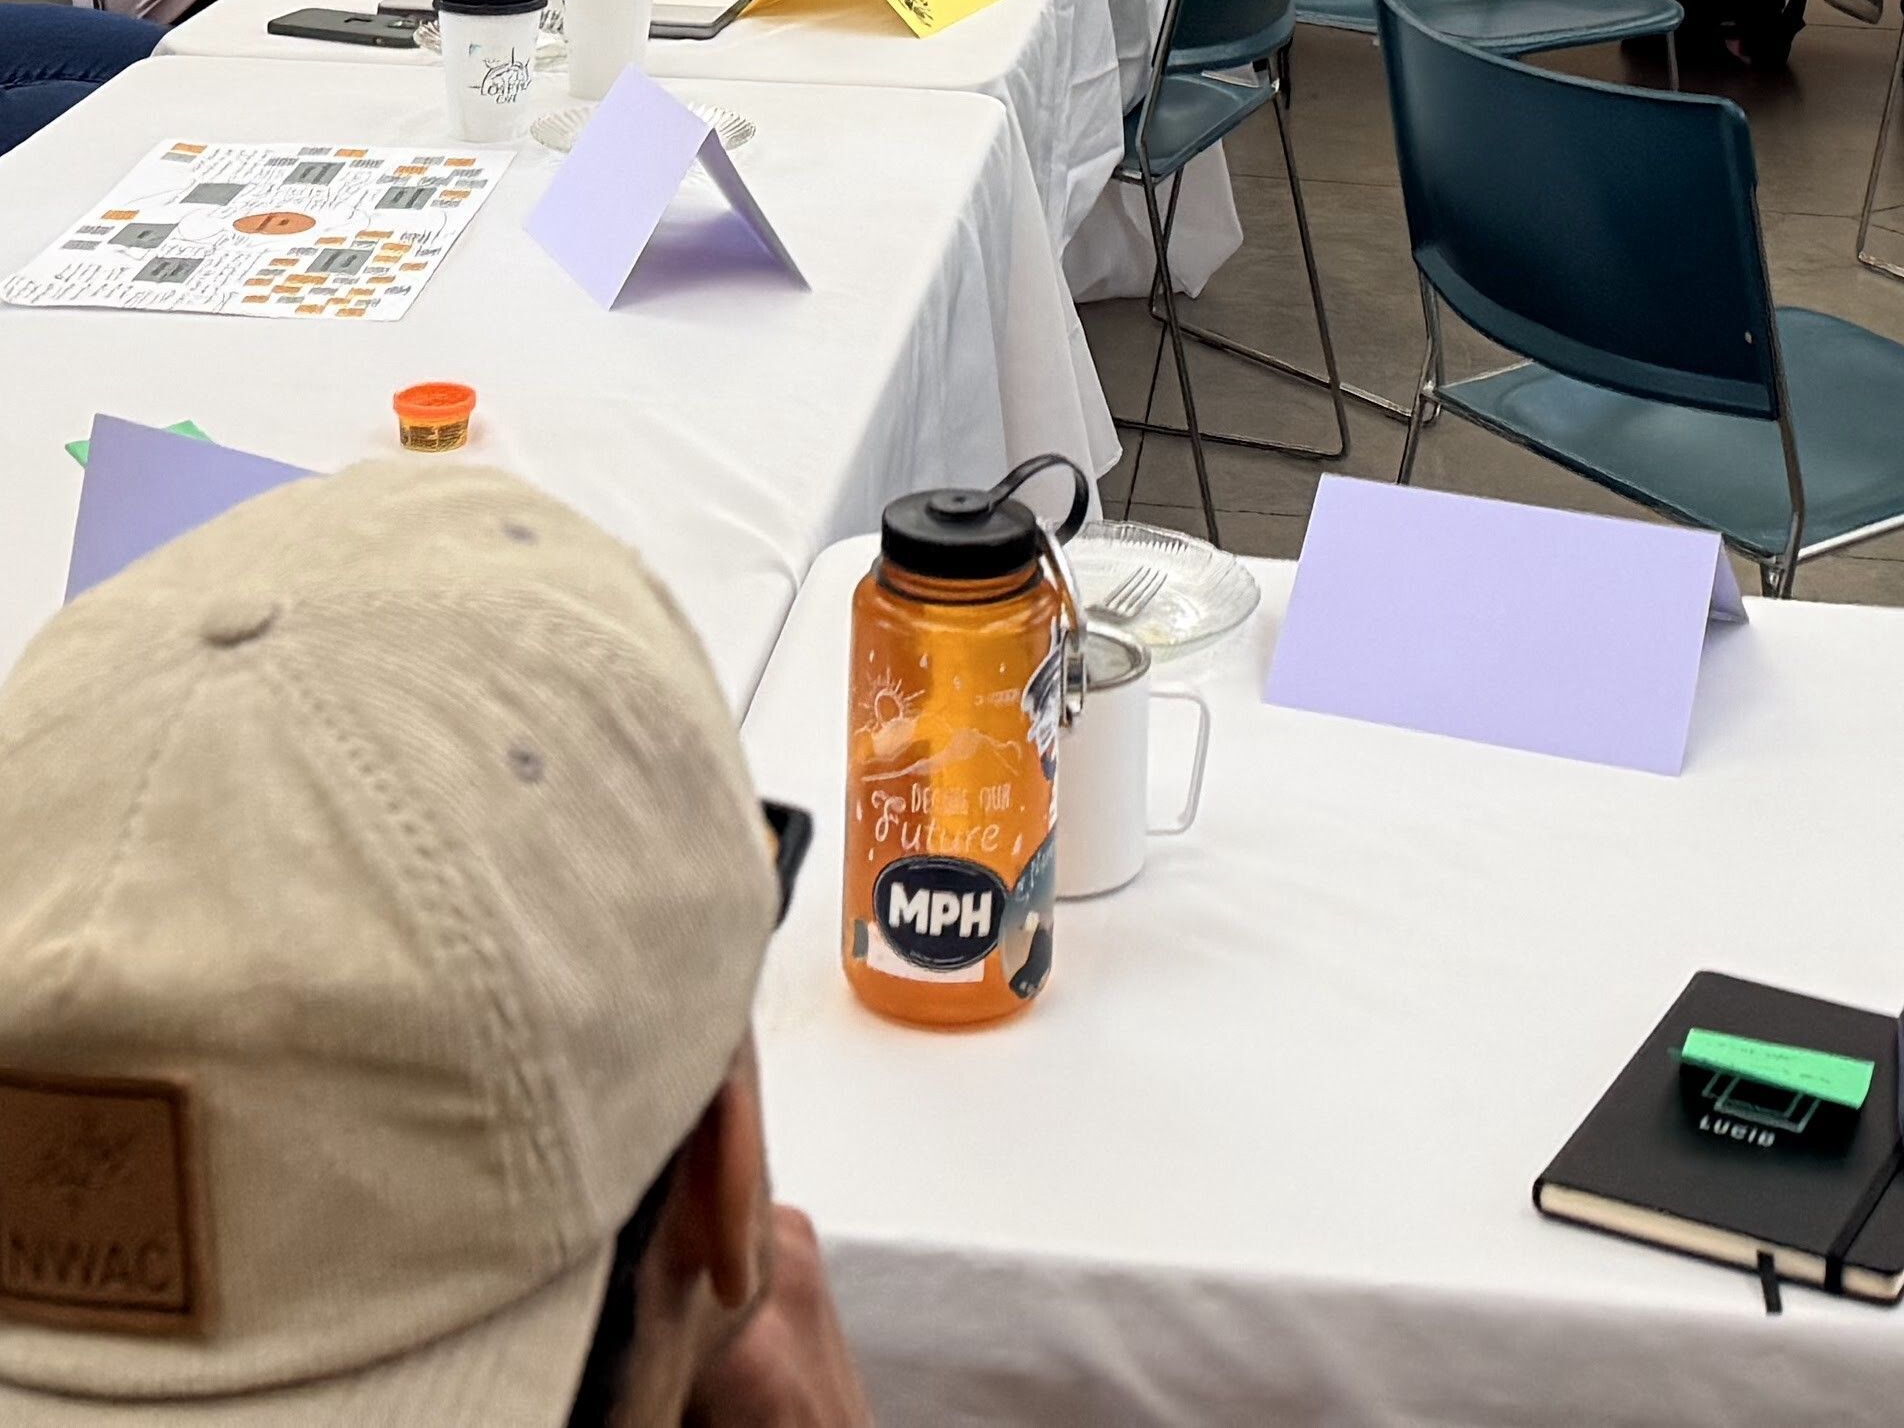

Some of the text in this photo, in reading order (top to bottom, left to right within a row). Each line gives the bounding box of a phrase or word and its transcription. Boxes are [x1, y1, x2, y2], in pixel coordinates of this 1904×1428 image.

[870, 788, 1000, 854] Future
[888, 881, 994, 939] MPH
[1699, 1114, 1776, 1148] LUCID
[8, 1232, 170, 1292] NWAC
